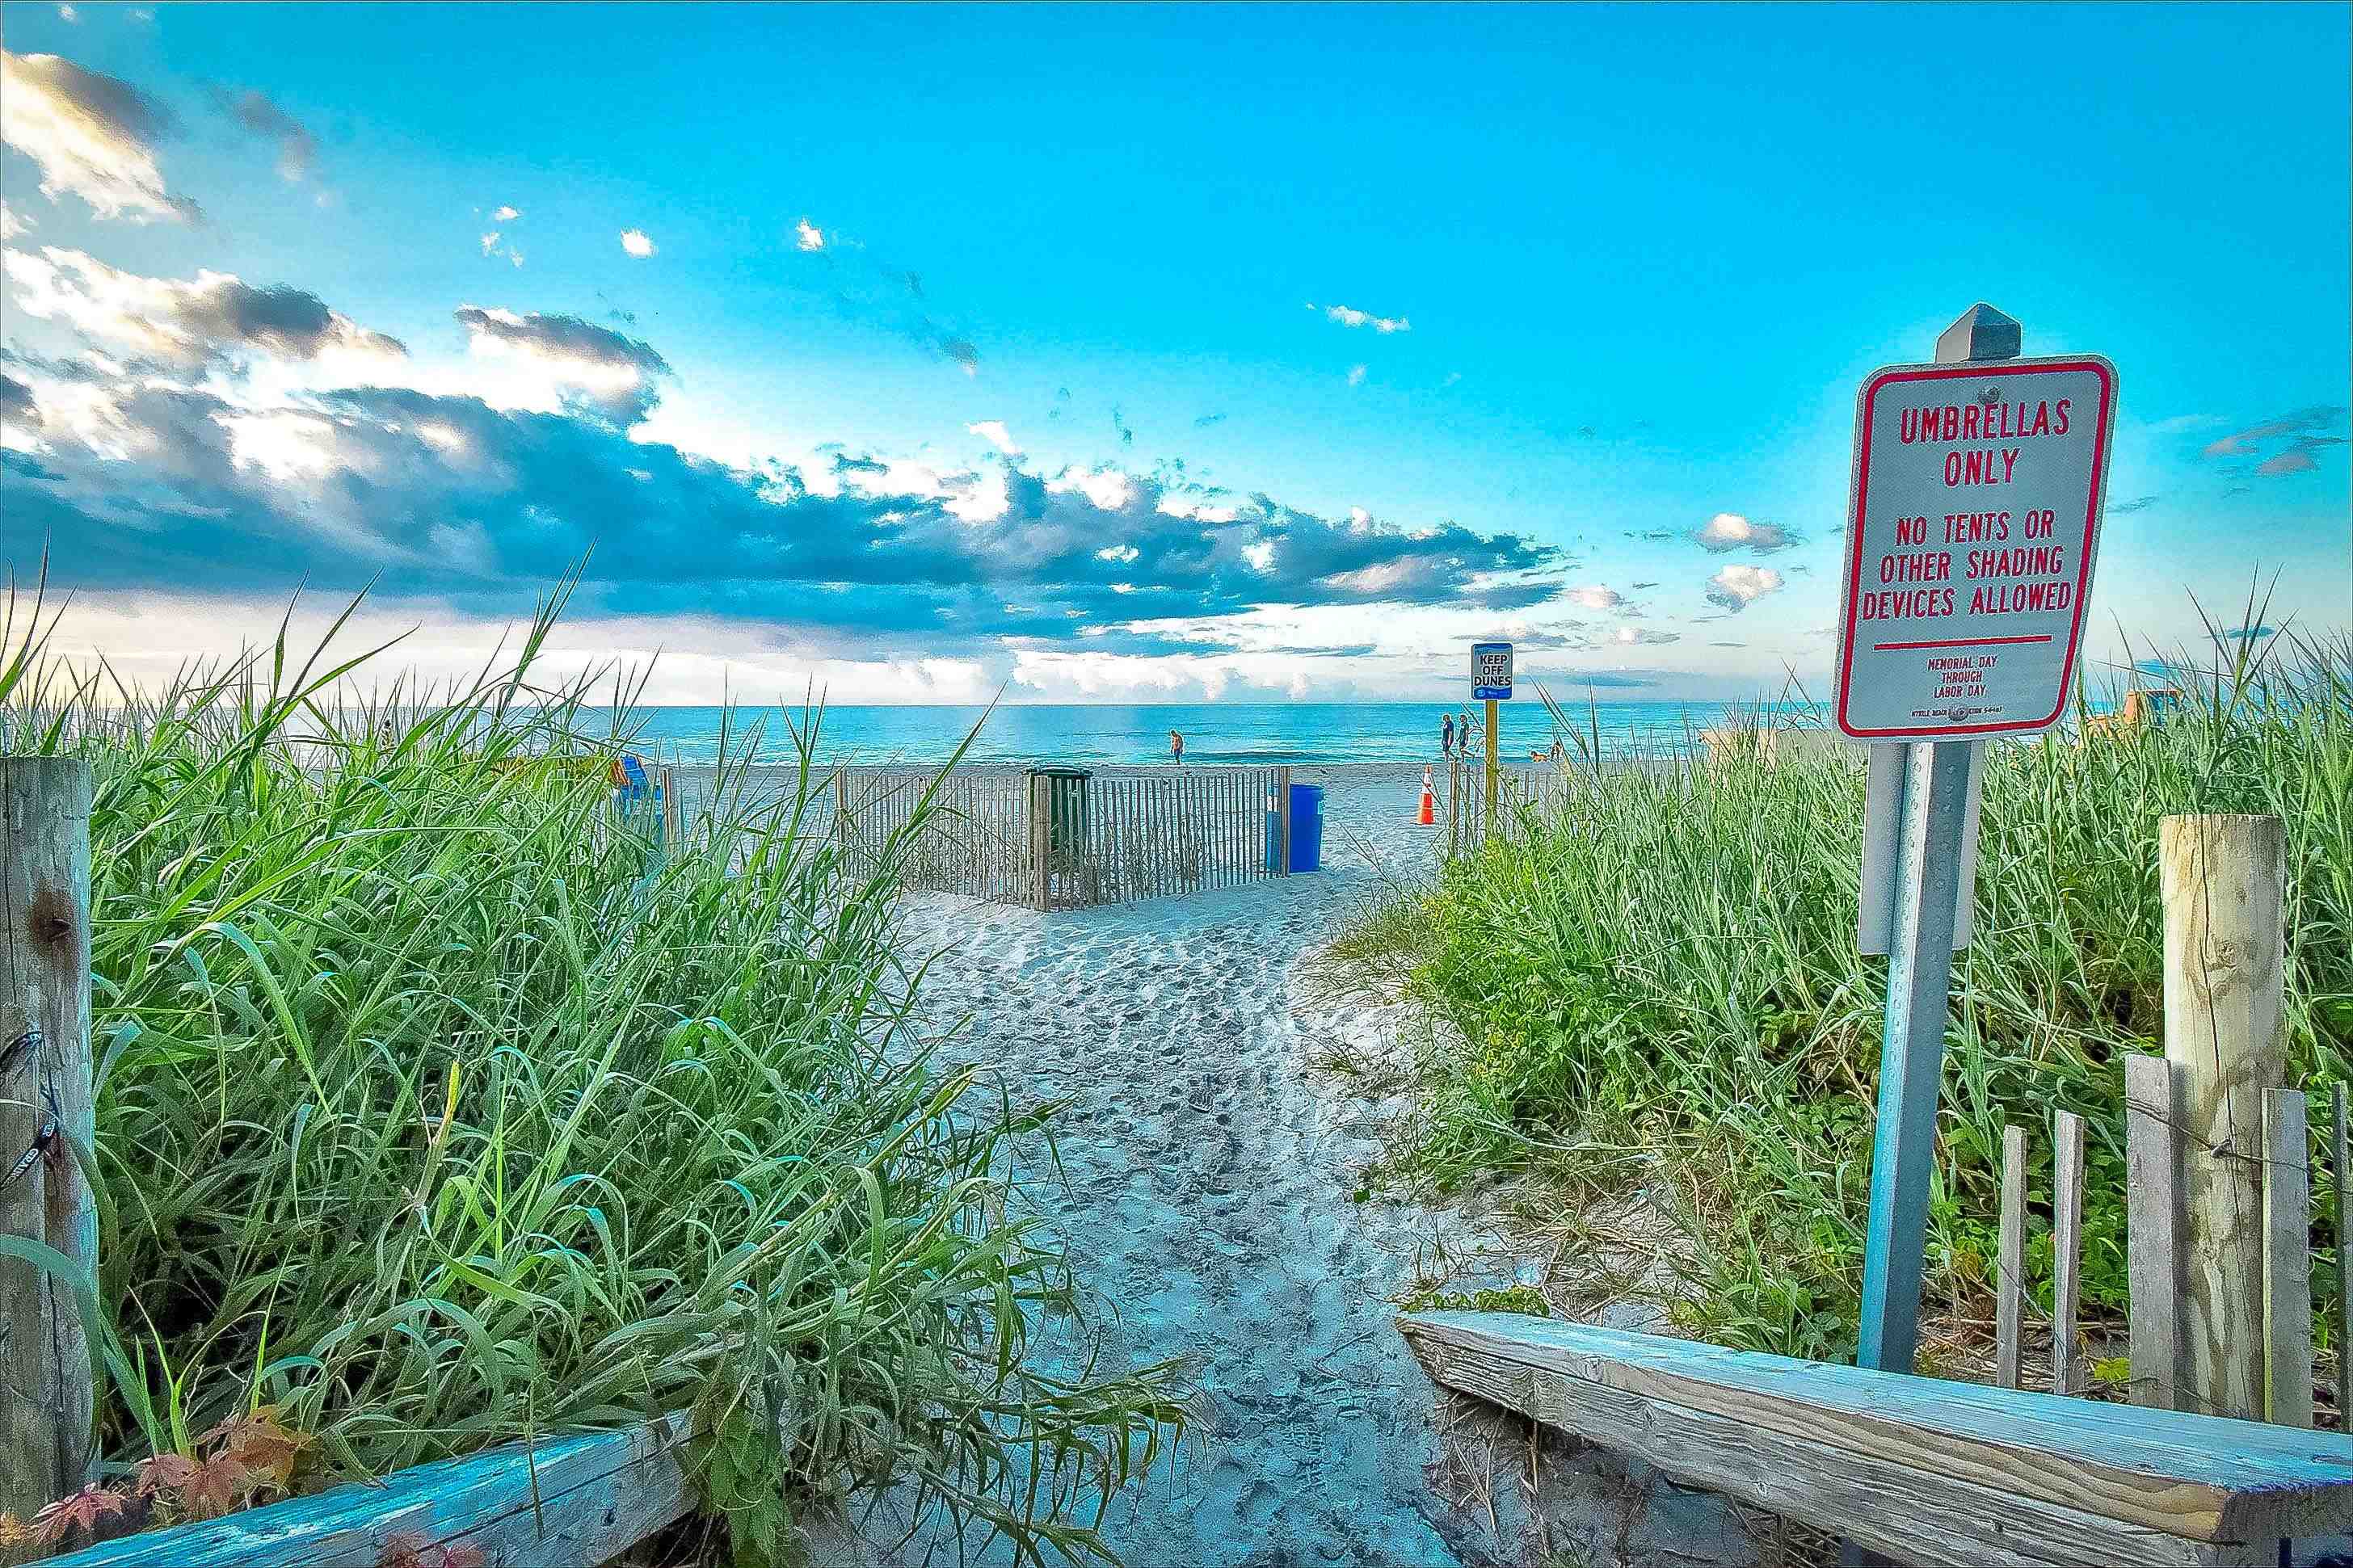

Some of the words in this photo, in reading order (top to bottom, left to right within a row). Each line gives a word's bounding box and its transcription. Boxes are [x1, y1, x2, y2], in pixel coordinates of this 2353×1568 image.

[1900, 400, 2071, 443] UMBRELLAS
[1944, 448, 2020, 486] ONLY
[1895, 516, 1927, 545] NO
[1944, 512, 2011, 543] TENTS
[2025, 510, 2055, 539] OR
[1879, 552, 1951, 583] OTHER
[1965, 546, 2064, 579] SHADING
[1863, 588, 1955, 620] DEVICES
[1969, 582, 2071, 615] ALLOWED
[1480, 654, 1508, 665] KEEP
[1927, 658, 1973, 670] MEMORIAL
[1979, 655, 1998, 667] DAY
[1482, 666, 1504, 675] OFF
[1942, 671, 1983, 683] THROUGH
[1474, 676, 1511, 686] DUNES
[1934, 687, 1964, 698] LABOR
[1968, 684, 1987, 696] DAY
